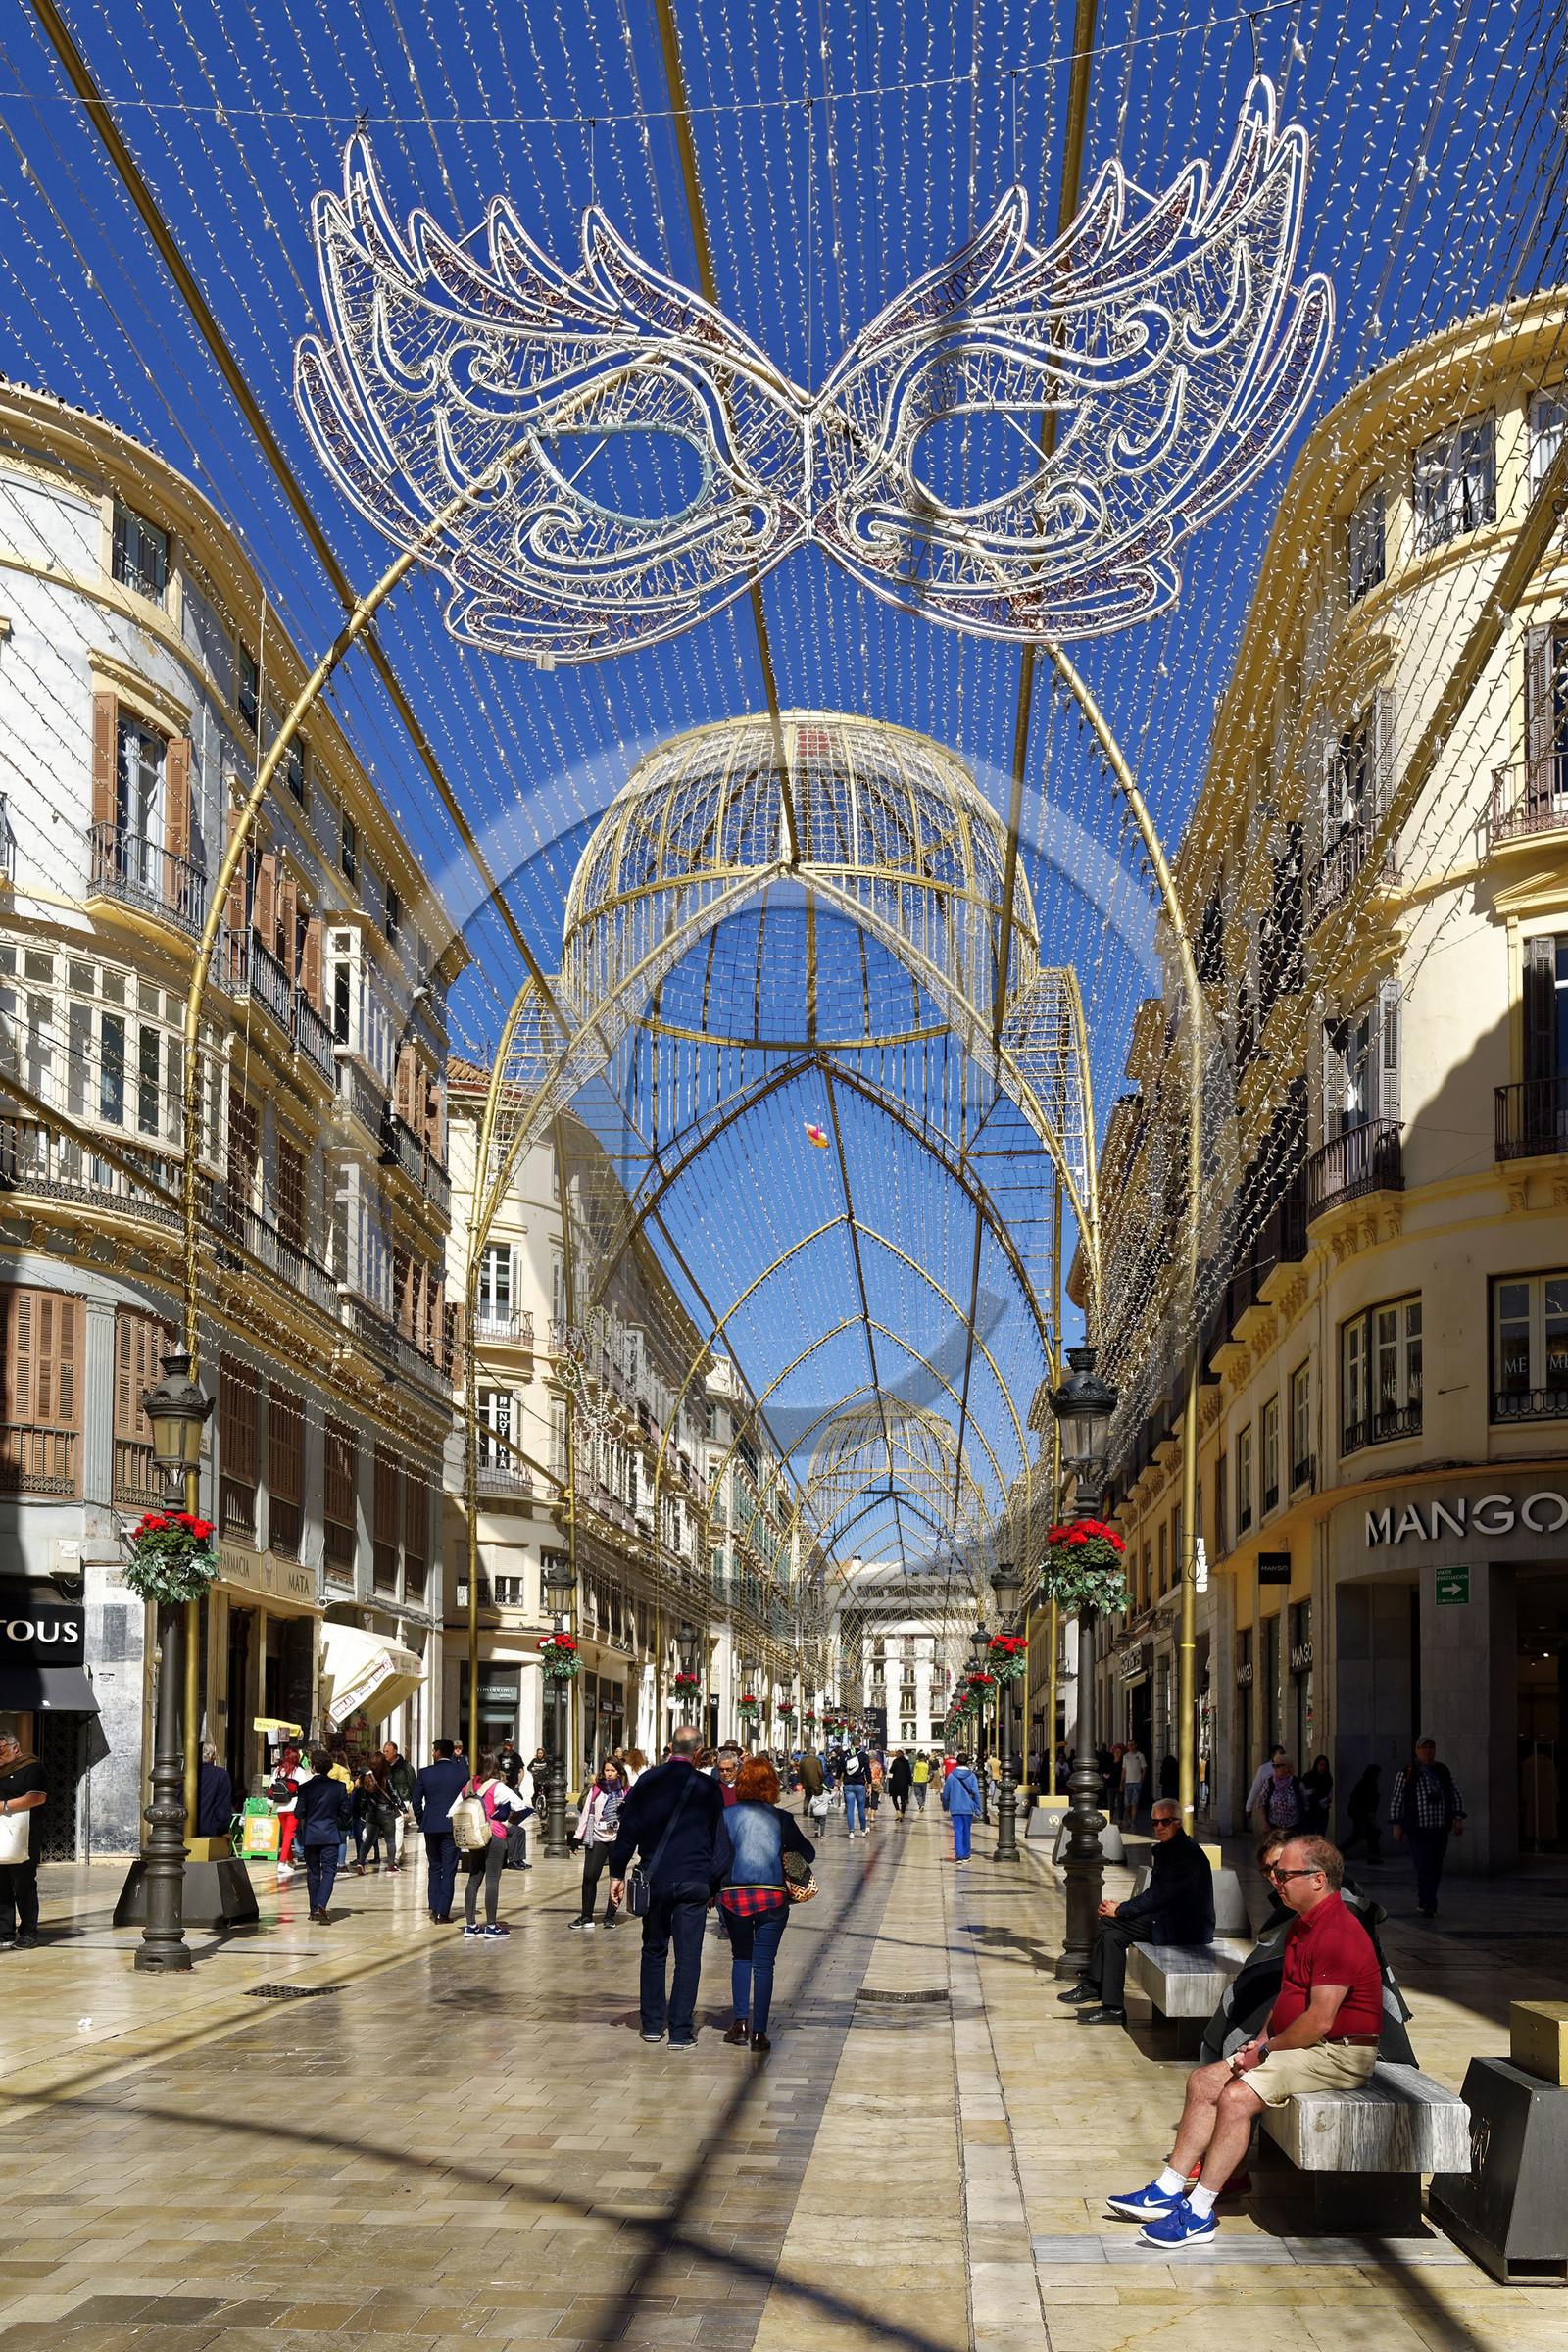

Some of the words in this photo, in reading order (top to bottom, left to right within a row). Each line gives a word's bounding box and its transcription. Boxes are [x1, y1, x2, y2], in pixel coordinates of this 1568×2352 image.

[499, 1412, 508, 1468] NOTRIA
[1365, 1492, 1568, 1547] MANGO
[220, 1549, 250, 1579] FARMACIA
[288, 1571, 310, 1595] MATA
